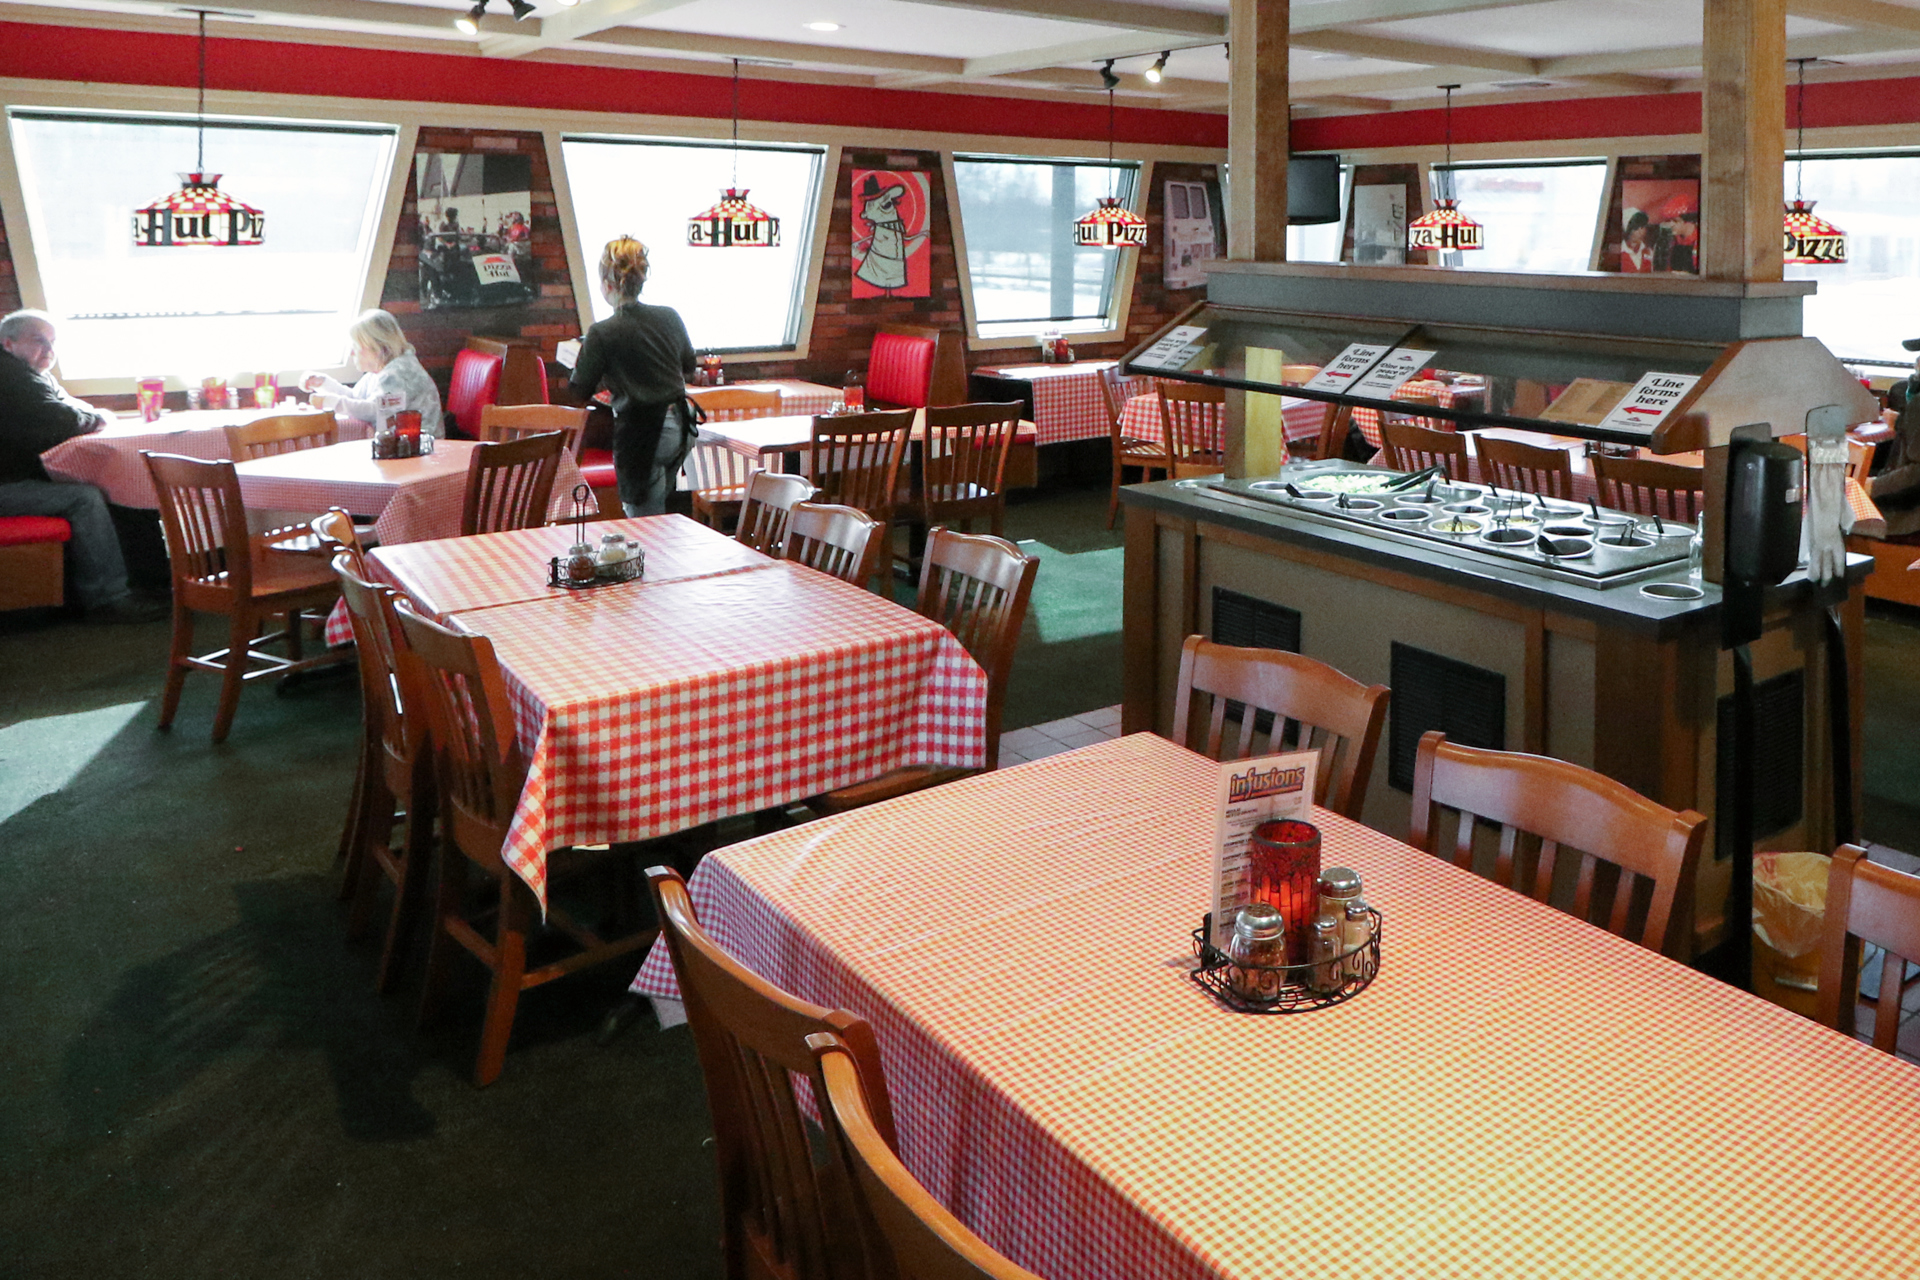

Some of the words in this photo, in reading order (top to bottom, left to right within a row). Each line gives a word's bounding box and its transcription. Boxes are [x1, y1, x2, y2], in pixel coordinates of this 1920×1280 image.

[141, 208, 219, 245] Hut
[704, 217, 763, 246] Hut
[1107, 221, 1147, 246] Pizz
[1435, 224, 1478, 248] Hut
[1353, 348, 1376, 357] Line
[1340, 354, 1371, 364] forms
[1336, 362, 1360, 370] here
[1651, 377, 1685, 389] Line
[1638, 386, 1681, 398] forms
[1635, 395, 1669, 406] here
[1230, 766, 1306, 799] infusions
